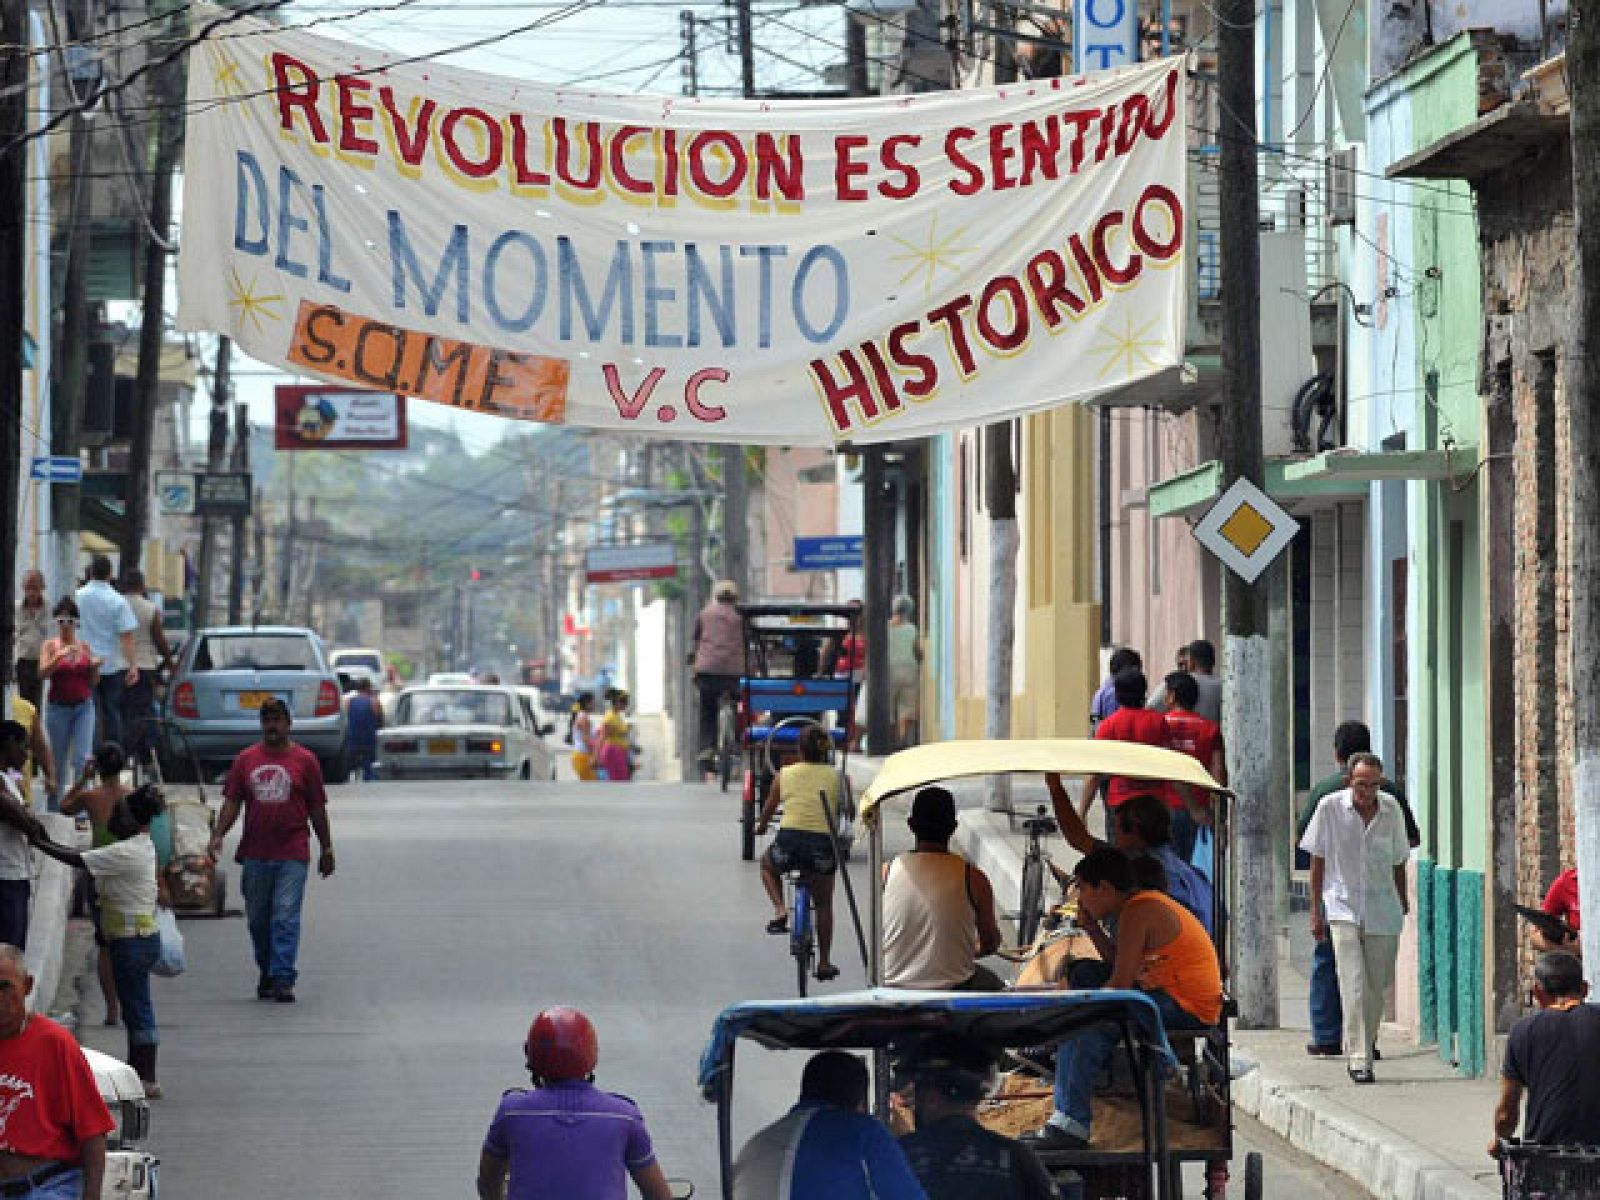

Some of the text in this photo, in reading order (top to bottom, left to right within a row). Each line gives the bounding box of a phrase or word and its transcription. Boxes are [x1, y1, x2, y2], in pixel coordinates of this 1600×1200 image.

[271, 51, 804, 201] REVOLUCION
[834, 134, 922, 201] ES
[235, 149, 1184, 431] DEL MOMENTO HISTORICO
[602, 362, 731, 422] V.C
